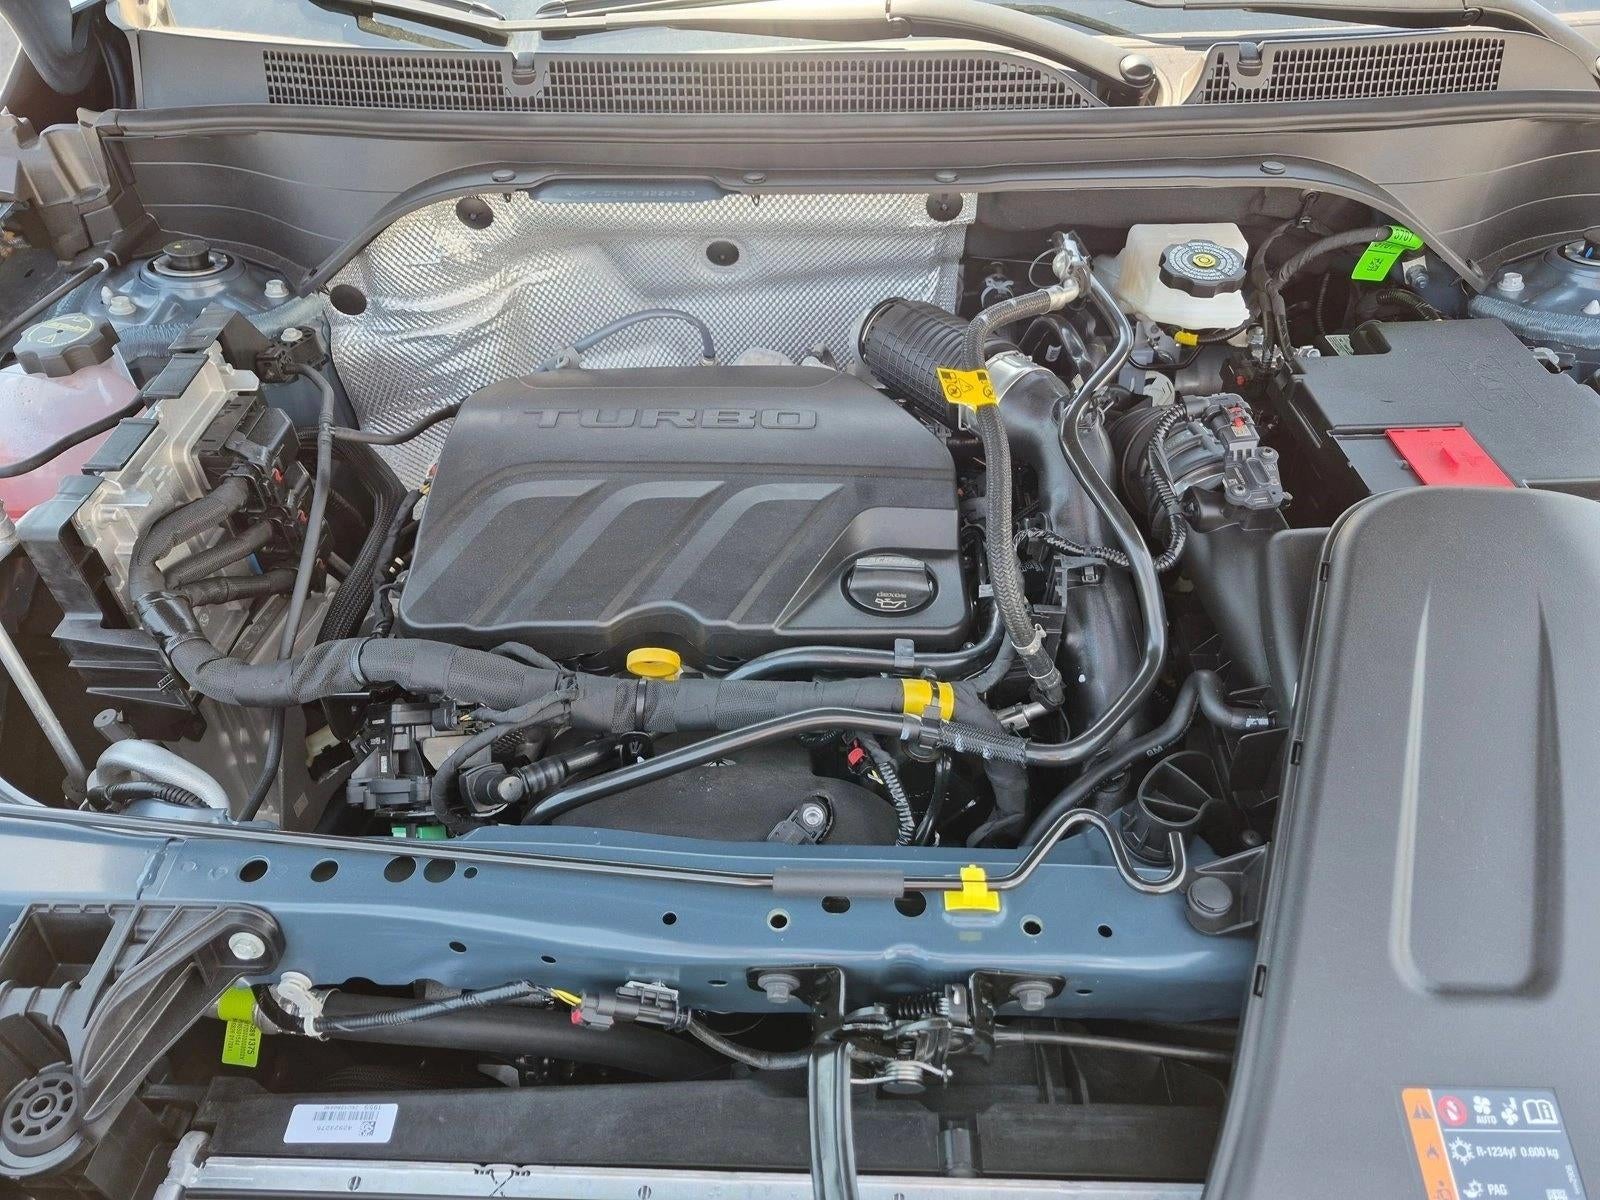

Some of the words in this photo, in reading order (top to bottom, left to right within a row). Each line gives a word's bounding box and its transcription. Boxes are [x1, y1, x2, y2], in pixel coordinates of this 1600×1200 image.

[523, 408, 817, 429] TURBO
[876, 591, 907, 599] dexos
[1476, 1115, 1497, 1124] AUTO
[1476, 1145, 1516, 1159] R-1234yf
[1520, 1146, 1546, 1158] 0.600
[1546, 1146, 1559, 1160] kg
[1487, 1183, 1508, 1196] PAG
